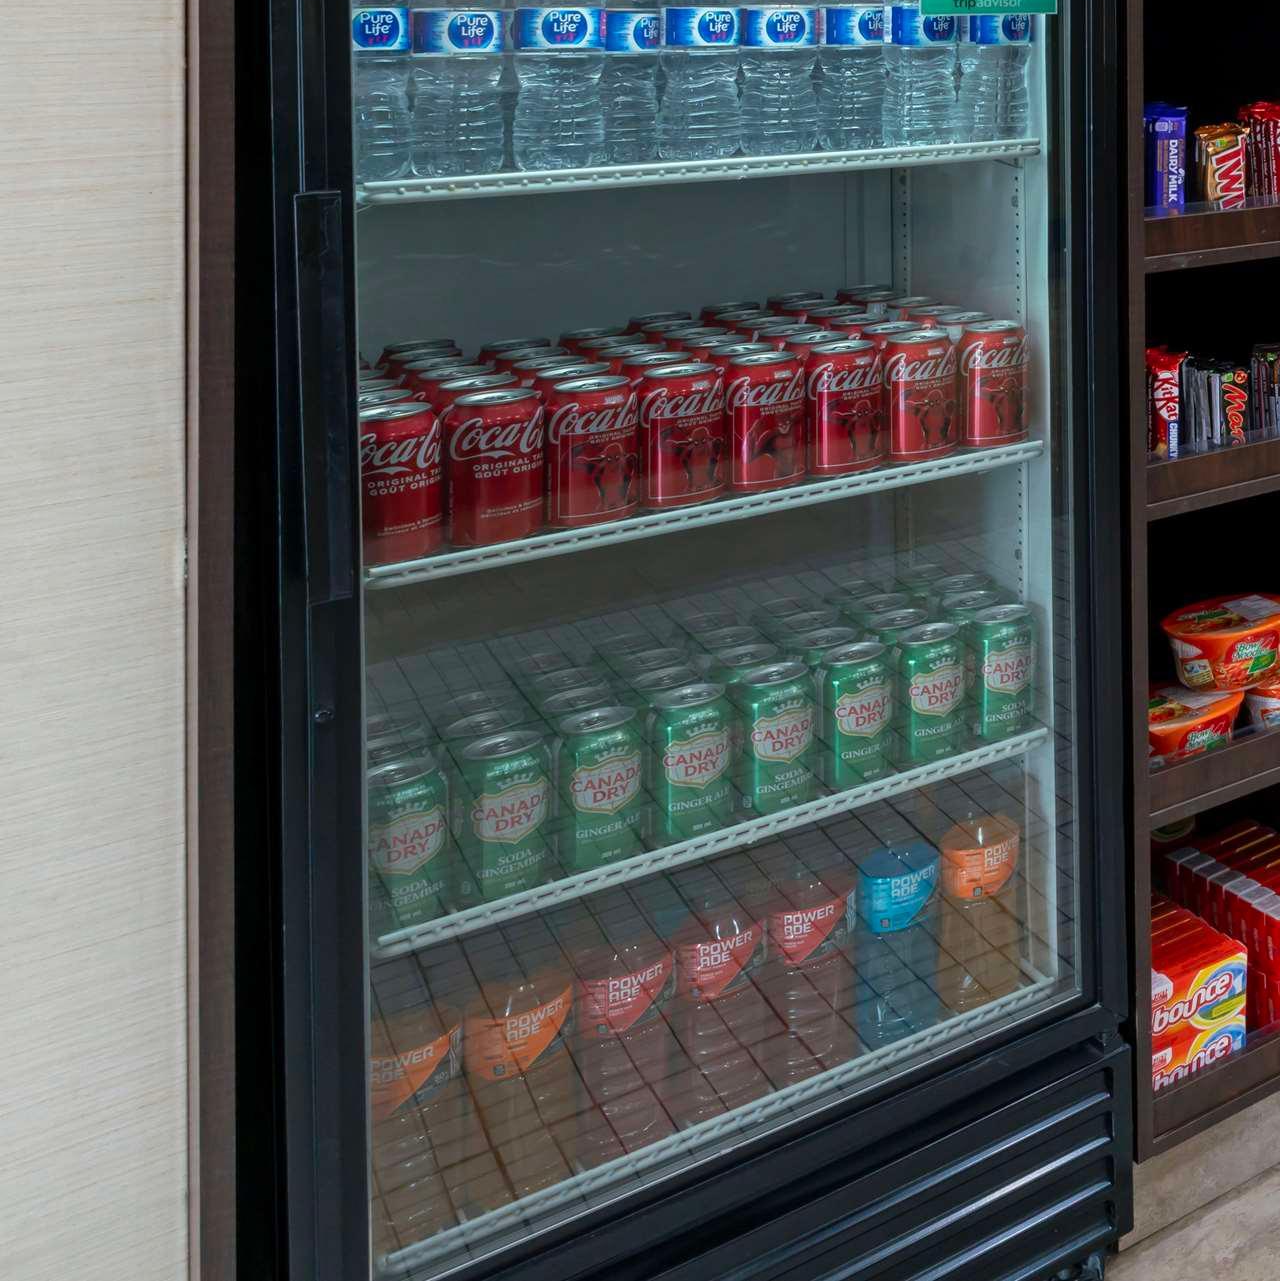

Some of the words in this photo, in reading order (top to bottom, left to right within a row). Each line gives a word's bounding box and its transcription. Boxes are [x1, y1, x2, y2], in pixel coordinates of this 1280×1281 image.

[360, 12, 393, 26] Pure
[457, 14, 488, 27] Pure
[550, 11, 582, 24] Pure
[706, 12, 731, 24] Pure
[773, 12, 800, 24] Pure
[865, 11, 884, 22] Pur
[365, 23, 391, 36] Life
[461, 25, 486, 38] Life
[553, 21, 578, 34] Life
[709, 22, 729, 33] Life
[777, 22, 798, 33] Life
[934, 21, 949, 32] Life
[1011, 21, 1025, 31] Life
[1168, 139, 1178, 175] DAIRY
[1212, 133, 1247, 210] TWI
[1168, 175, 1178, 202] MILK
[1154, 376, 1179, 420] KitKat
[473, 456, 530, 472] ORIGINAL
[367, 472, 428, 489] ORIGINAL
[999, 669, 1028, 685] DRY
[927, 690, 958, 707] DRY
[855, 710, 886, 729] DRY
[771, 734, 805, 753] DRY
[841, 743, 880, 760] GINGER
[684, 757, 721, 778] DRY
[592, 781, 630, 804] DRY
[668, 793, 713, 812] GINGER
[495, 810, 535, 833] DRY
[576, 820, 623, 840] GINGER
[386, 838, 431, 864] DRY
[497, 847, 534, 865] SODA
[891, 863, 937, 890] POWER
[391, 878, 429, 898] SODA
[784, 904, 835, 926] POWER
[700, 929, 753, 957] POWER
[608, 962, 664, 993] POWER
[1151, 972, 1233, 1034] bounce
[506, 997, 564, 1029] POWER
